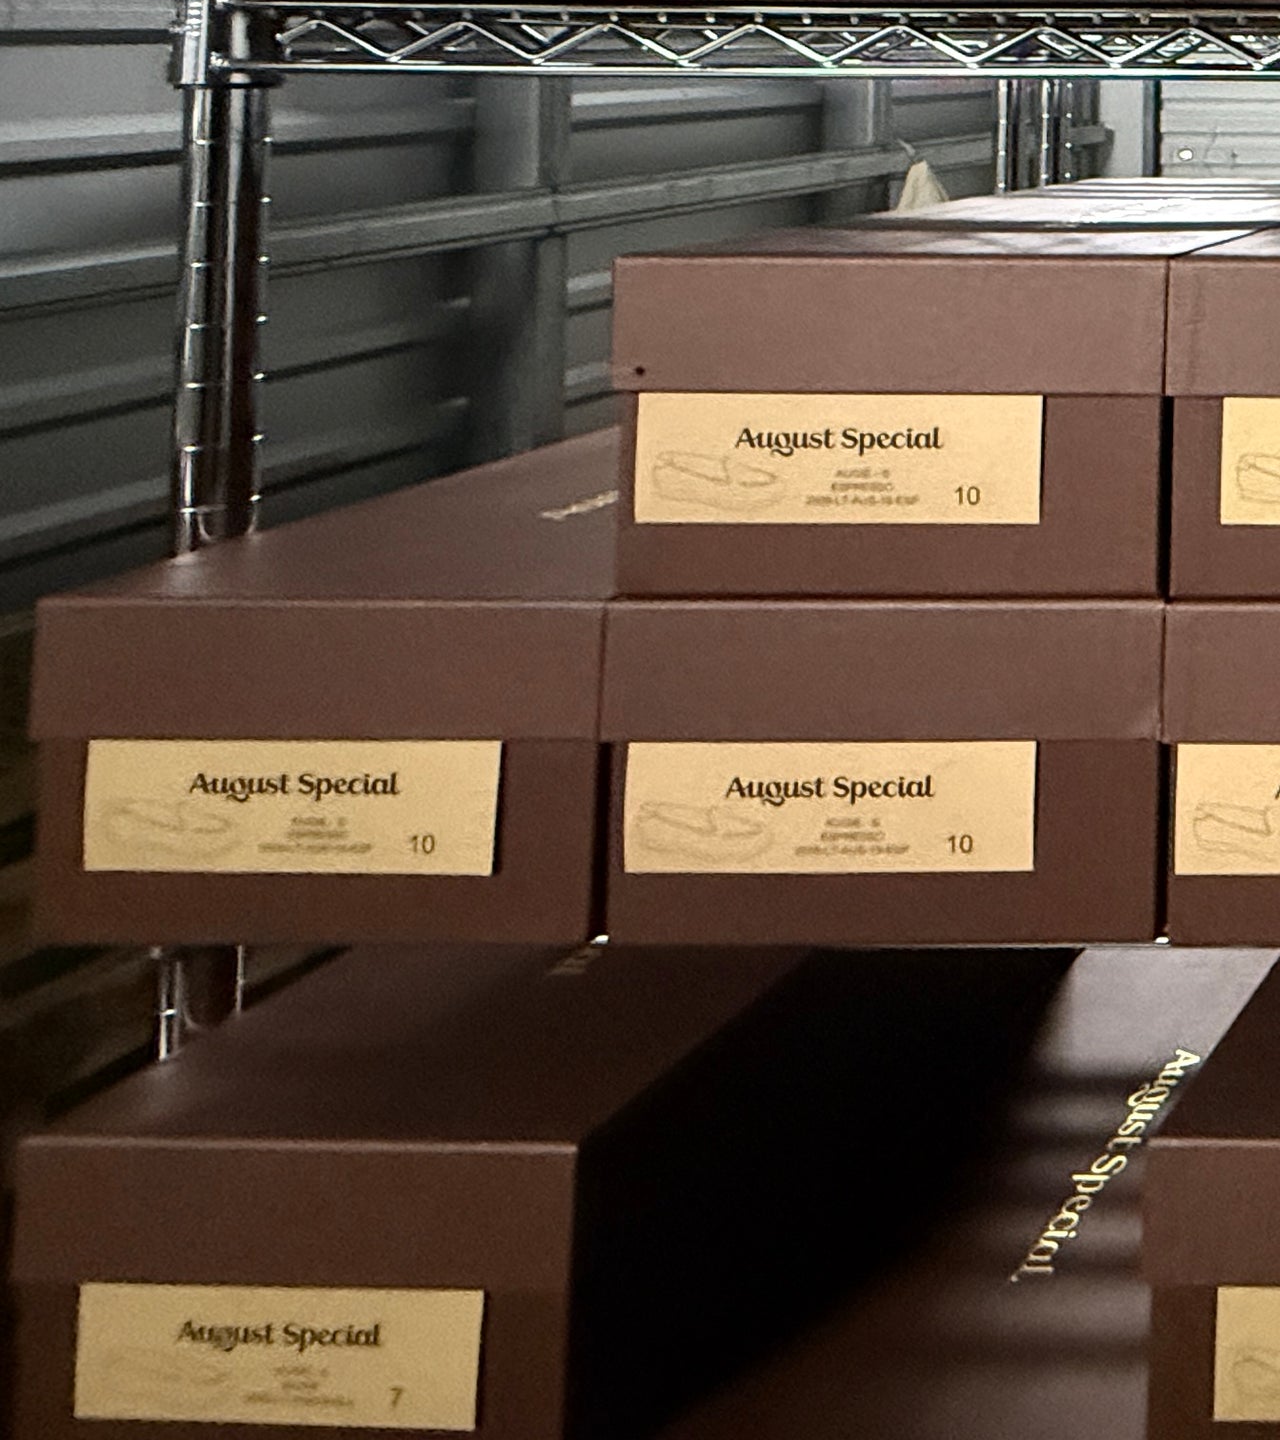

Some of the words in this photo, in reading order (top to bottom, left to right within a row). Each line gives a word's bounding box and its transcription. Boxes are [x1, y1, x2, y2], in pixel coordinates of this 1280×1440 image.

[735, 428, 835, 457] August
[841, 427, 943, 456] Special
[955, 486, 980, 505] 10
[189, 773, 289, 803] August
[298, 772, 400, 802] Special
[726, 777, 825, 807] August
[833, 775, 934, 805] Special
[410, 834, 435, 855] 10
[948, 834, 973, 854] 10
[1127, 1047, 1201, 1152] August
[1009, 1154, 1128, 1284] Special
[178, 1320, 275, 1352] August
[283, 1323, 381, 1353] Special
[390, 1386, 404, 1408] 7
